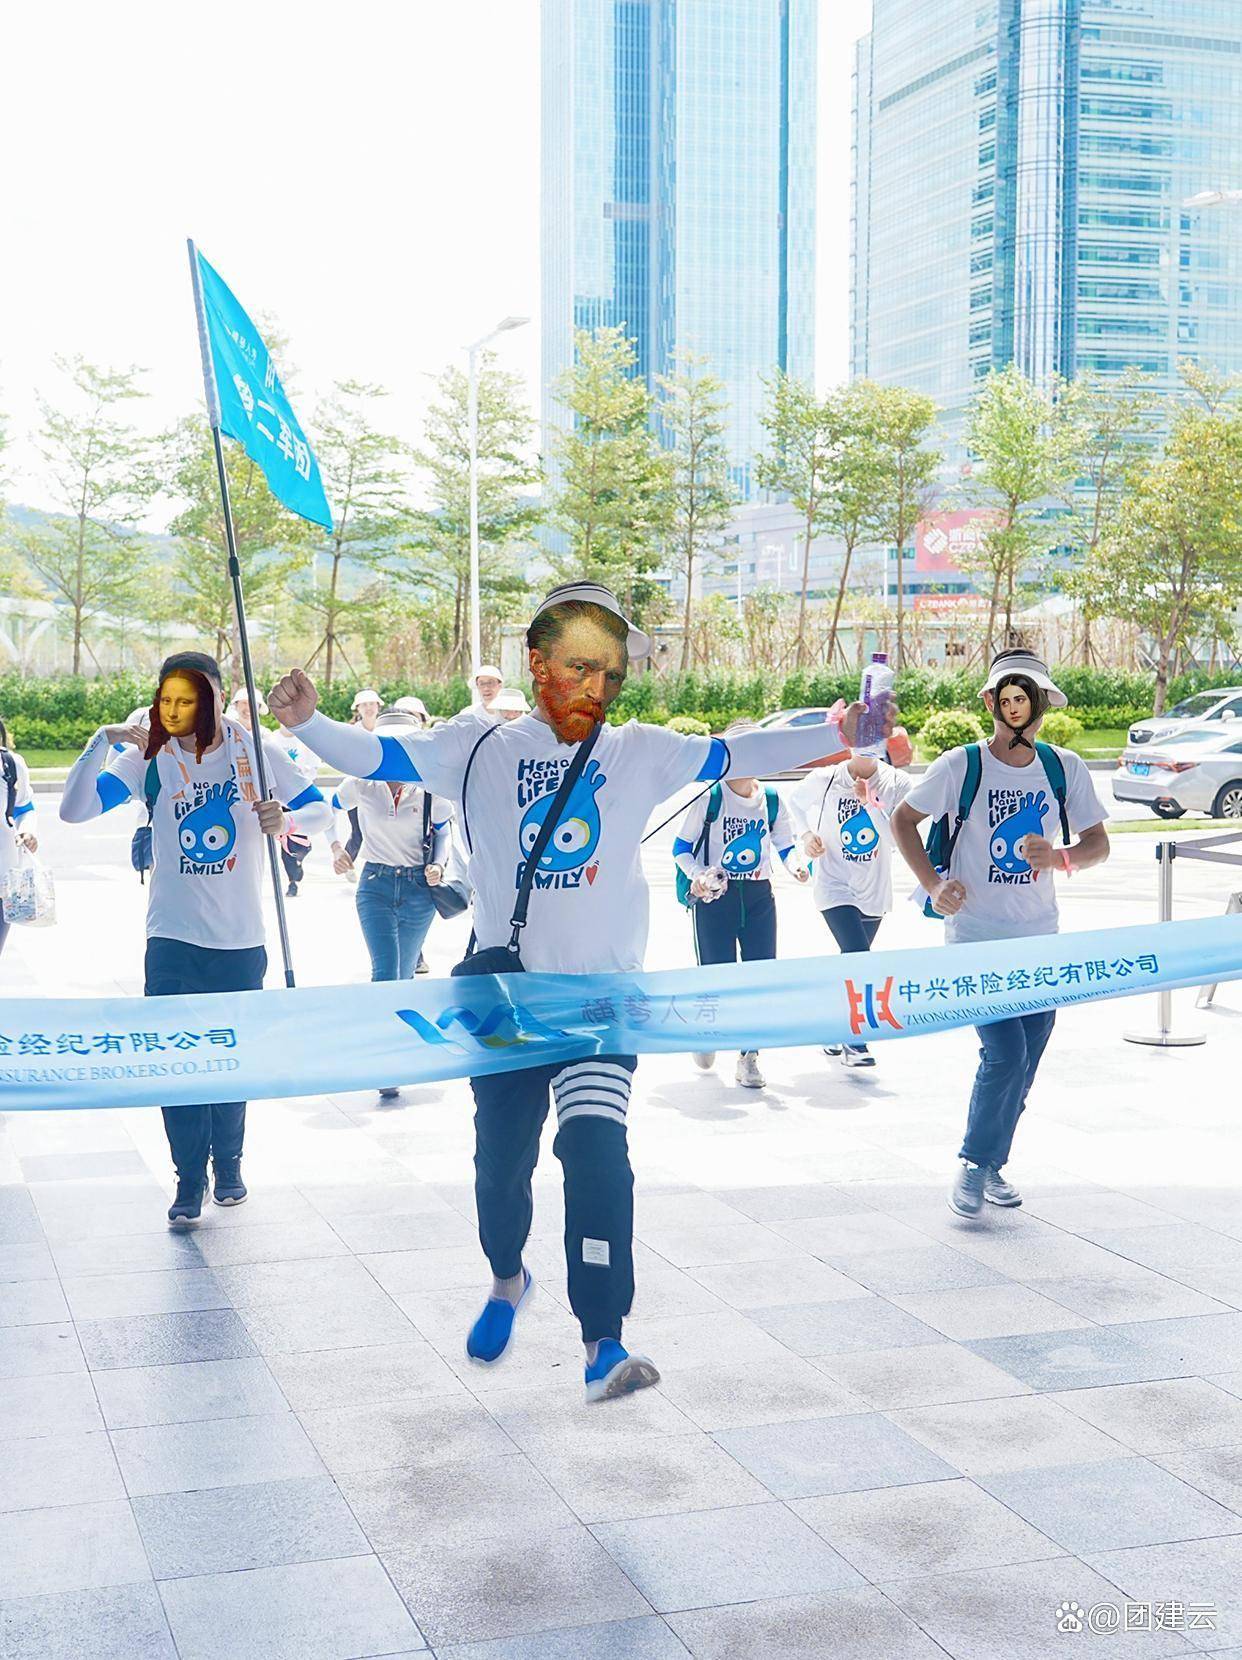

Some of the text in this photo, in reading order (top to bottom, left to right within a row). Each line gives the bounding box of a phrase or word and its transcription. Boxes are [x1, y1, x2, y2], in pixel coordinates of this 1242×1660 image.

[179, 855, 226, 875] FAMILY
[515, 861, 585, 889] FMILY
[988, 864, 1033, 884] FAMILY
[898, 953, 1160, 1003] 中兴保险经纪有限公司
[580, 993, 720, 1024] 横琴人寿
[903, 1005, 989, 1026] ZHONGXING
[90, 1063, 169, 1080] BROKERS
